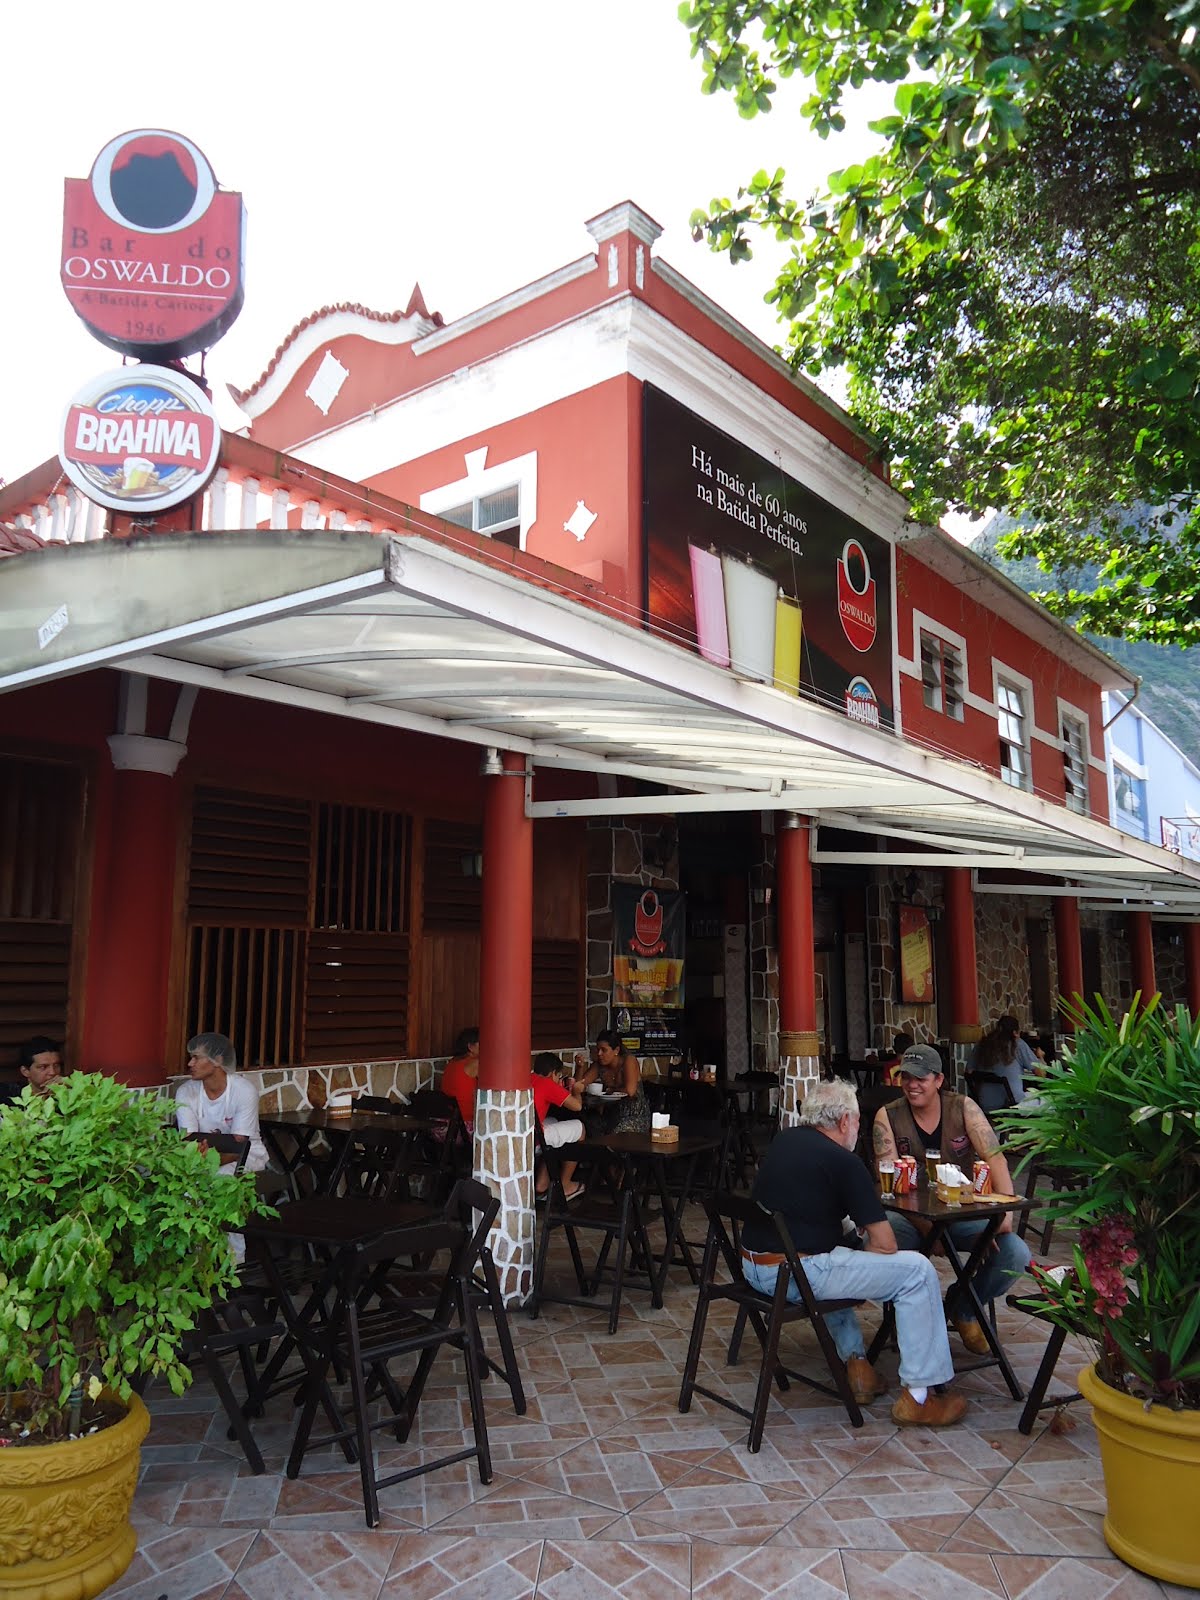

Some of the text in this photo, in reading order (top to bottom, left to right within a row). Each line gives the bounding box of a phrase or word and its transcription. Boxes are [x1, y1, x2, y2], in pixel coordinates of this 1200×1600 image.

[71, 227, 231, 261] Bar do
[65, 256, 231, 289] OSWALDO
[125, 320, 167, 337] 1946
[97, 394, 185, 416] Chopp
[75, 412, 201, 460] BRAHMA
[691, 444, 808, 534] Há mais de 60 anos
[697, 483, 804, 556] na Batida Perfeita.
[840, 599, 875, 627] OSWALDO
[846, 696, 880, 729] BRAHMA
